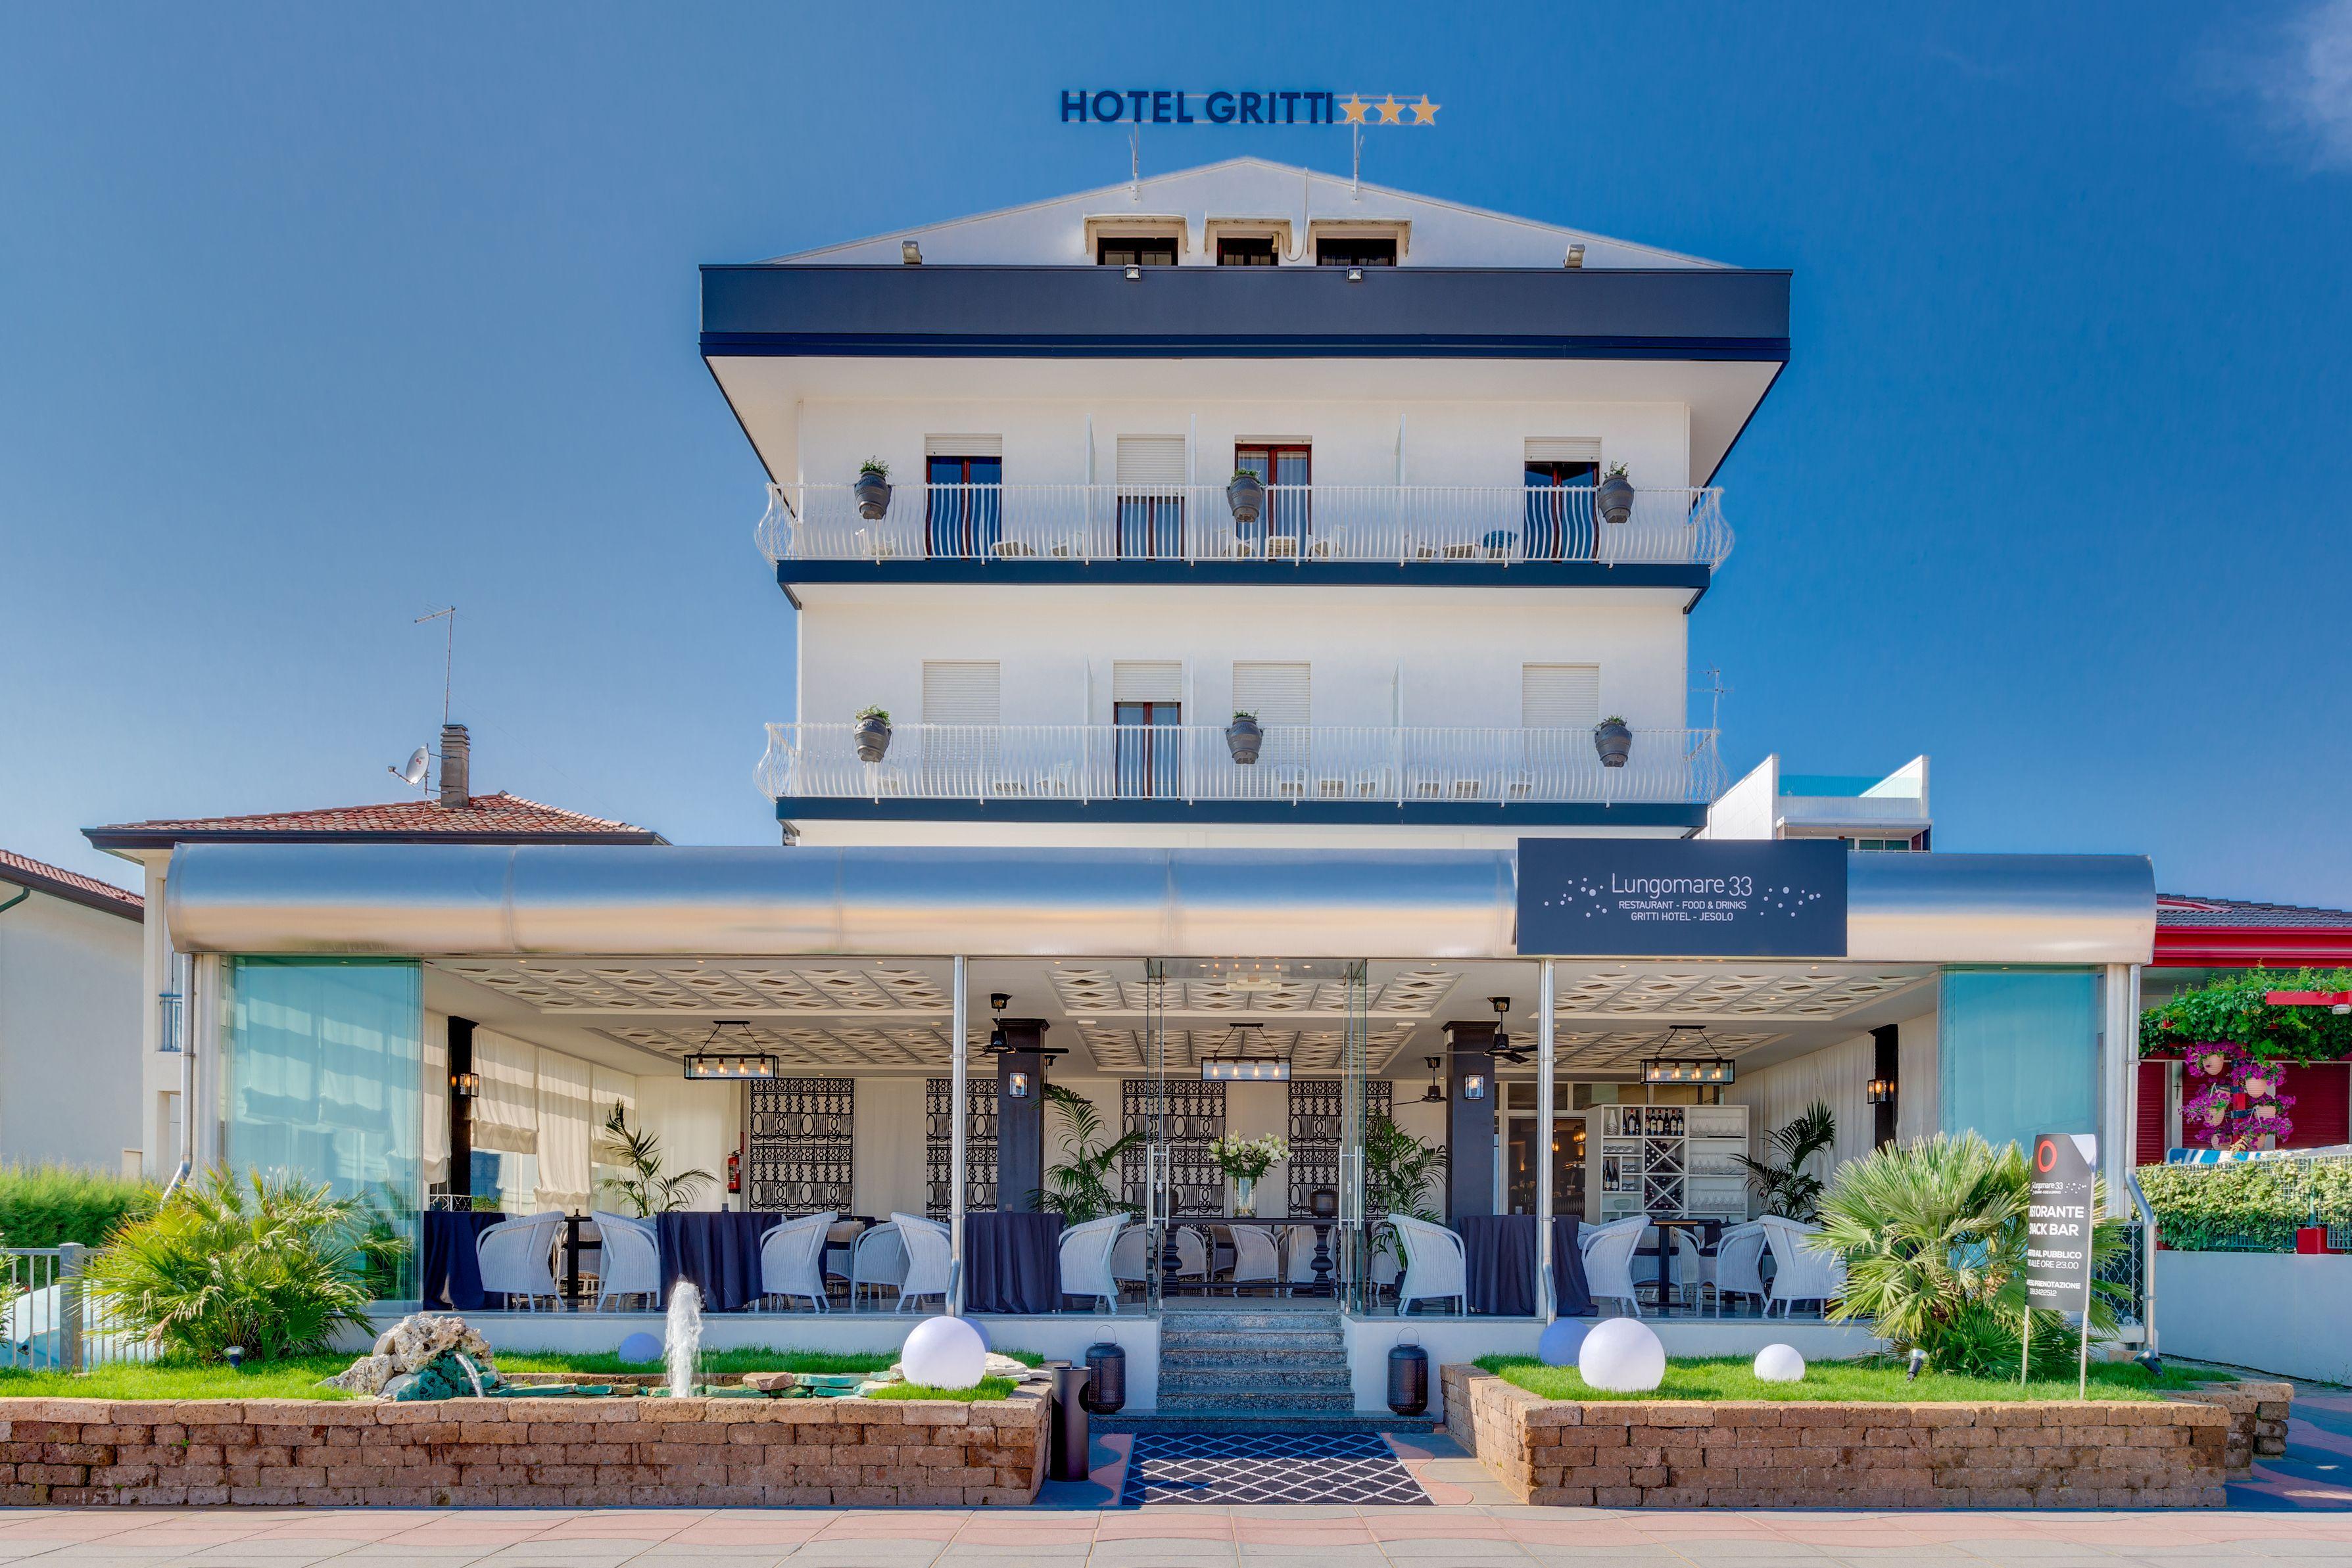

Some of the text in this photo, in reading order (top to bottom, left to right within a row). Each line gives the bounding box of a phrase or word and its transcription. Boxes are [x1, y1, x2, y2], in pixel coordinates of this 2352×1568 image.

[1061, 90, 1334, 124] HOTEL GRITTI
[1612, 872, 1752, 899] Lungomare 33
[1618, 901, 1673, 910] RESTAURANT
[1682, 901, 1706, 910] FOOD
[1707, 901, 1714, 910] &
[1716, 901, 1746, 910] DRINKS
[1631, 912, 1659, 921] GRITTI
[1662, 912, 1691, 921] HOTEL
[1699, 912, 1734, 922] JESOLO
[2055, 1181, 2063, 1190] 33
[2049, 1224, 2079, 1236] BAR
[2043, 1250, 2082, 1259] PUBBLICO
[2040, 1260, 2055, 1268] ORE
[2055, 1261, 2079, 1270] 23.00
[2034, 1279, 2081, 1289] PRENOTAZIONE
